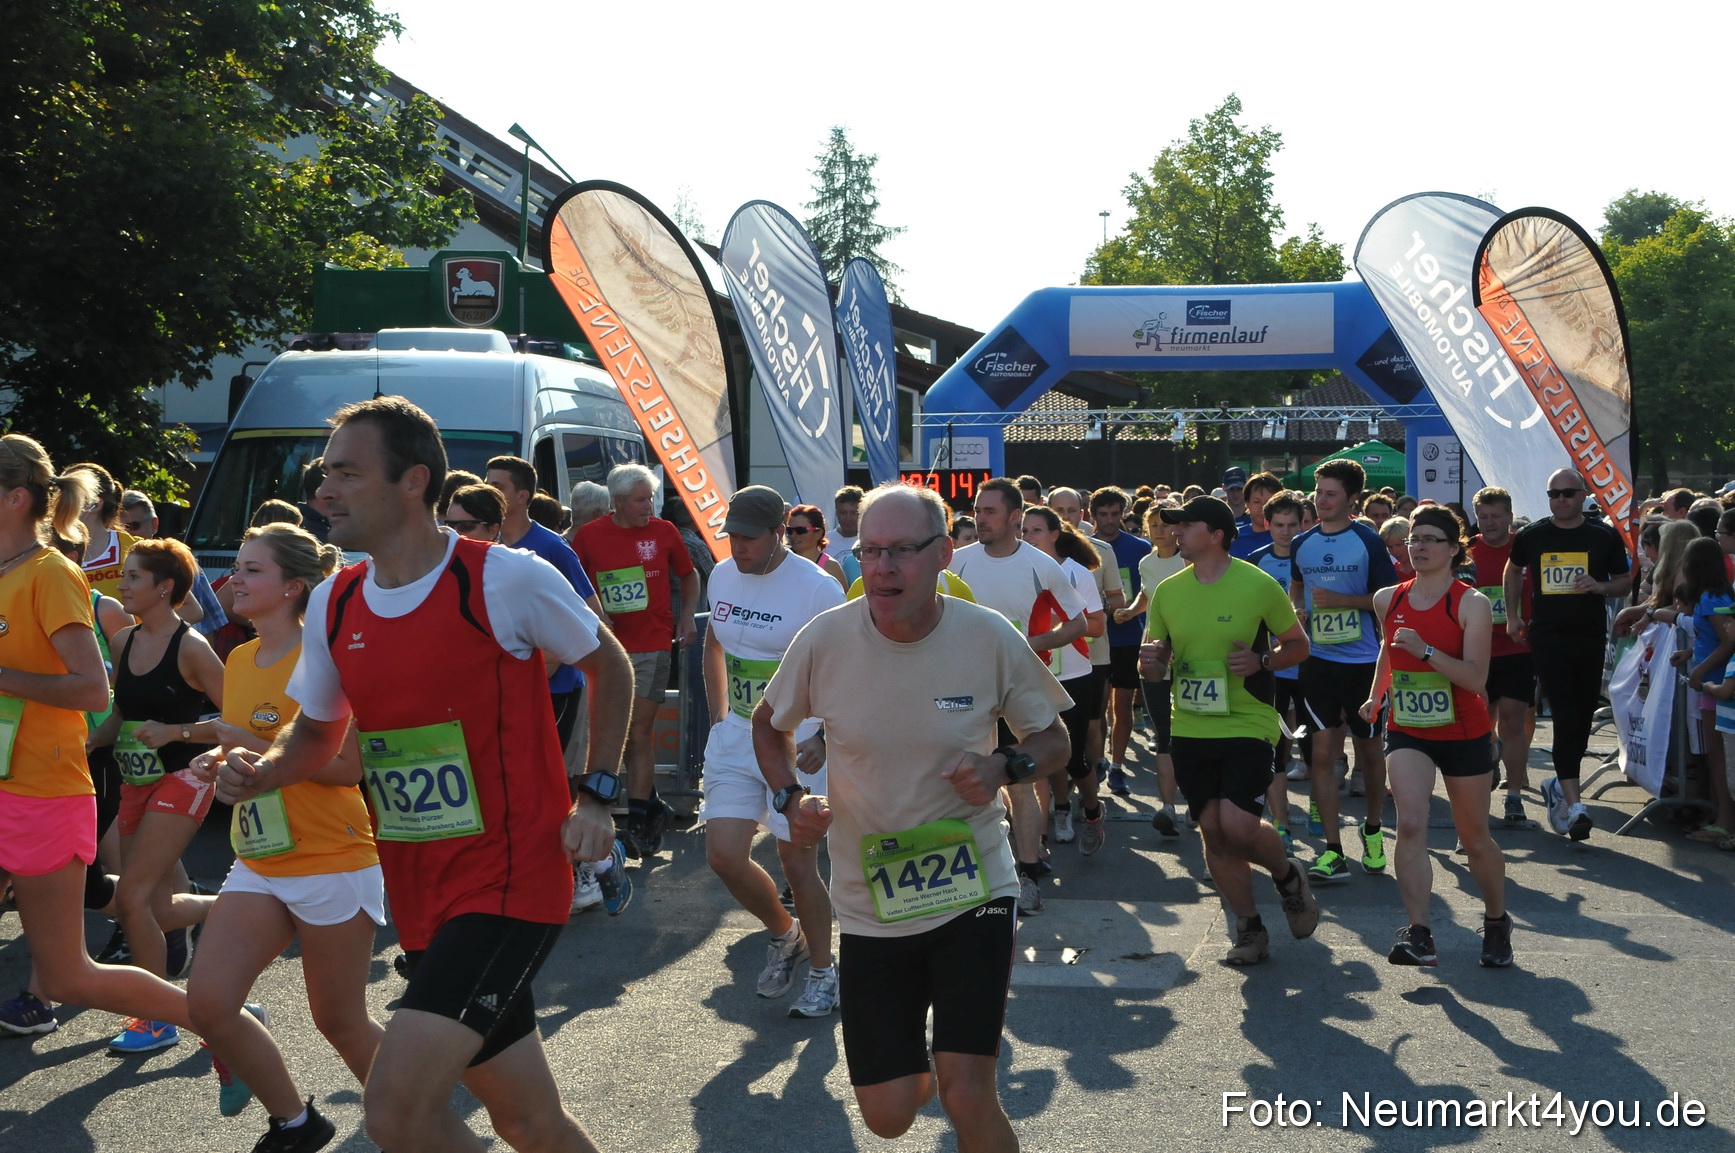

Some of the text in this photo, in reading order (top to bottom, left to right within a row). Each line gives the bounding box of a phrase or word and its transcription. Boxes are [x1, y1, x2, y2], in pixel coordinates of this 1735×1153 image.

[1195, 306, 1228, 317] Fischer
[1170, 325, 1269, 344] firmenlauf
[985, 360, 1037, 372] Fischer
[601, 582, 646, 604] 1332
[731, 606, 782, 623] Egner
[1313, 611, 1358, 633] 1214
[1180, 678, 1218, 702] 274
[1394, 690, 1450, 714] 1309
[115, 751, 162, 777] 5092
[369, 764, 468, 813] 1320
[238, 802, 264, 838] 61
[871, 845, 979, 899] 1424
[903, 887, 958, 904] Hans Werner Hack
[935, 897, 953, 905] GmbH
[987, 907, 1008, 915] asics
